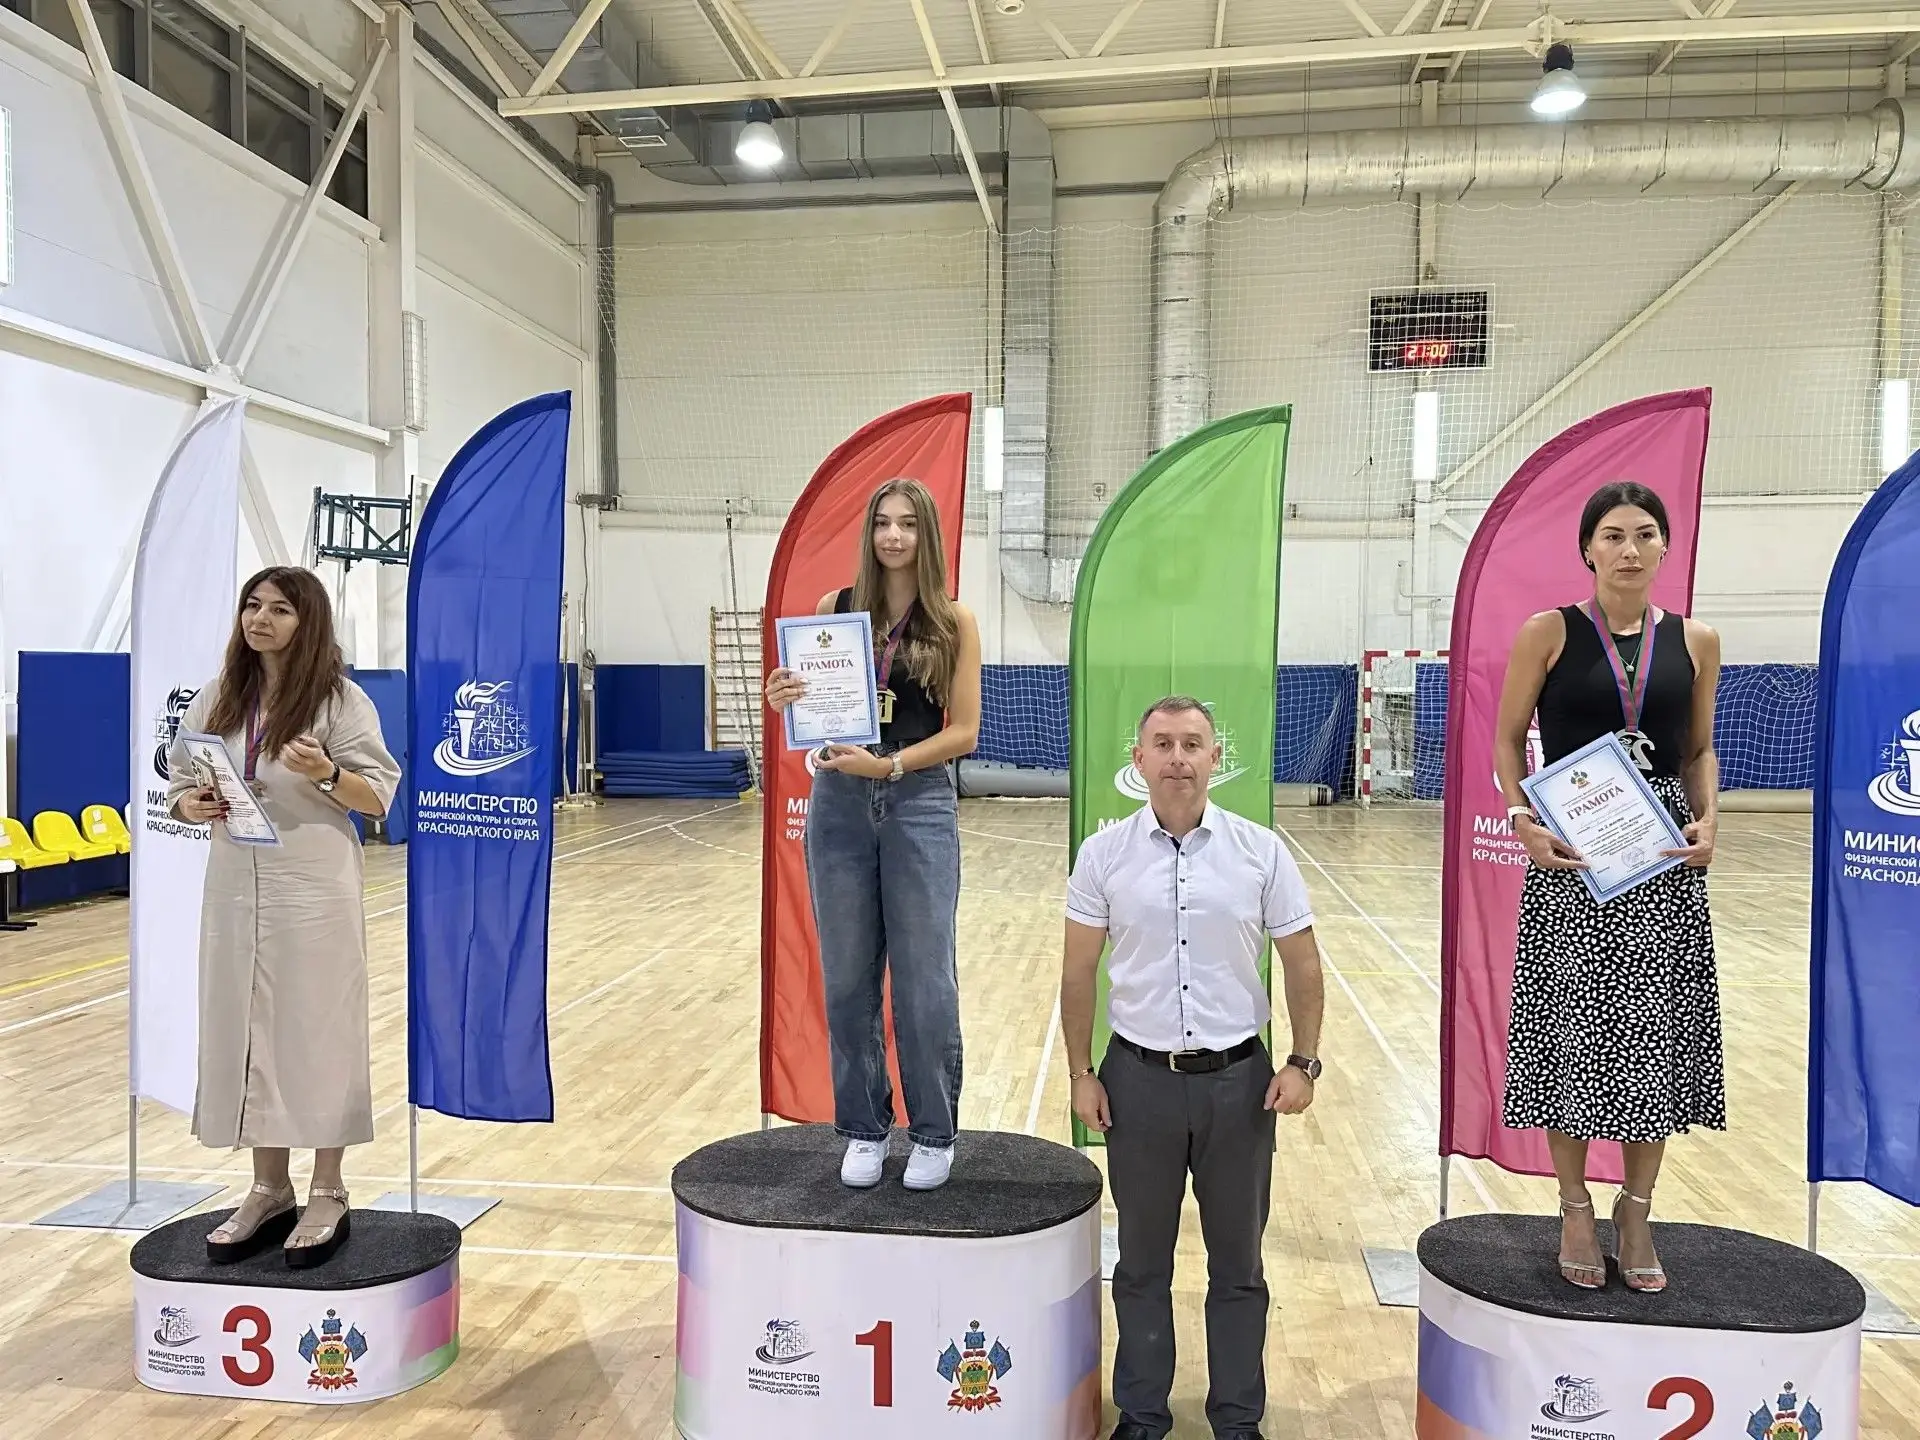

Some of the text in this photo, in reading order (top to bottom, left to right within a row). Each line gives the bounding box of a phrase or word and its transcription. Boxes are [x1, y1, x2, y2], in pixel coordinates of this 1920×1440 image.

[1407, 343, 1448, 361] 21:00
[800, 658, 853, 671] ГРАМОТА
[418, 790, 538, 815] МИНИСТЕРСТВО
[1566, 785, 1625, 820] ГРАМОТА
[418, 810, 465, 821] ФИЗИЧЕСКОЙ
[504, 817, 510, 825] И
[417, 821, 540, 841] КРАСНОДАРСКОГО КРАЯ
[1473, 836, 1526, 850] ФИЗИЧЕСК
[1845, 853, 1917, 867] ФИЗИЧЕСКОЙ
[222, 1305, 275, 1387] 3
[148, 1349, 205, 1364] МИНИСТЕРСТВО
[855, 1320, 893, 1407] 1
[748, 1367, 820, 1383] МИНИСТЕРСТВО
[748, 1384, 803, 1396] КРАСНОДАРСКОГО
[1647, 1377, 1715, 1440] 2
